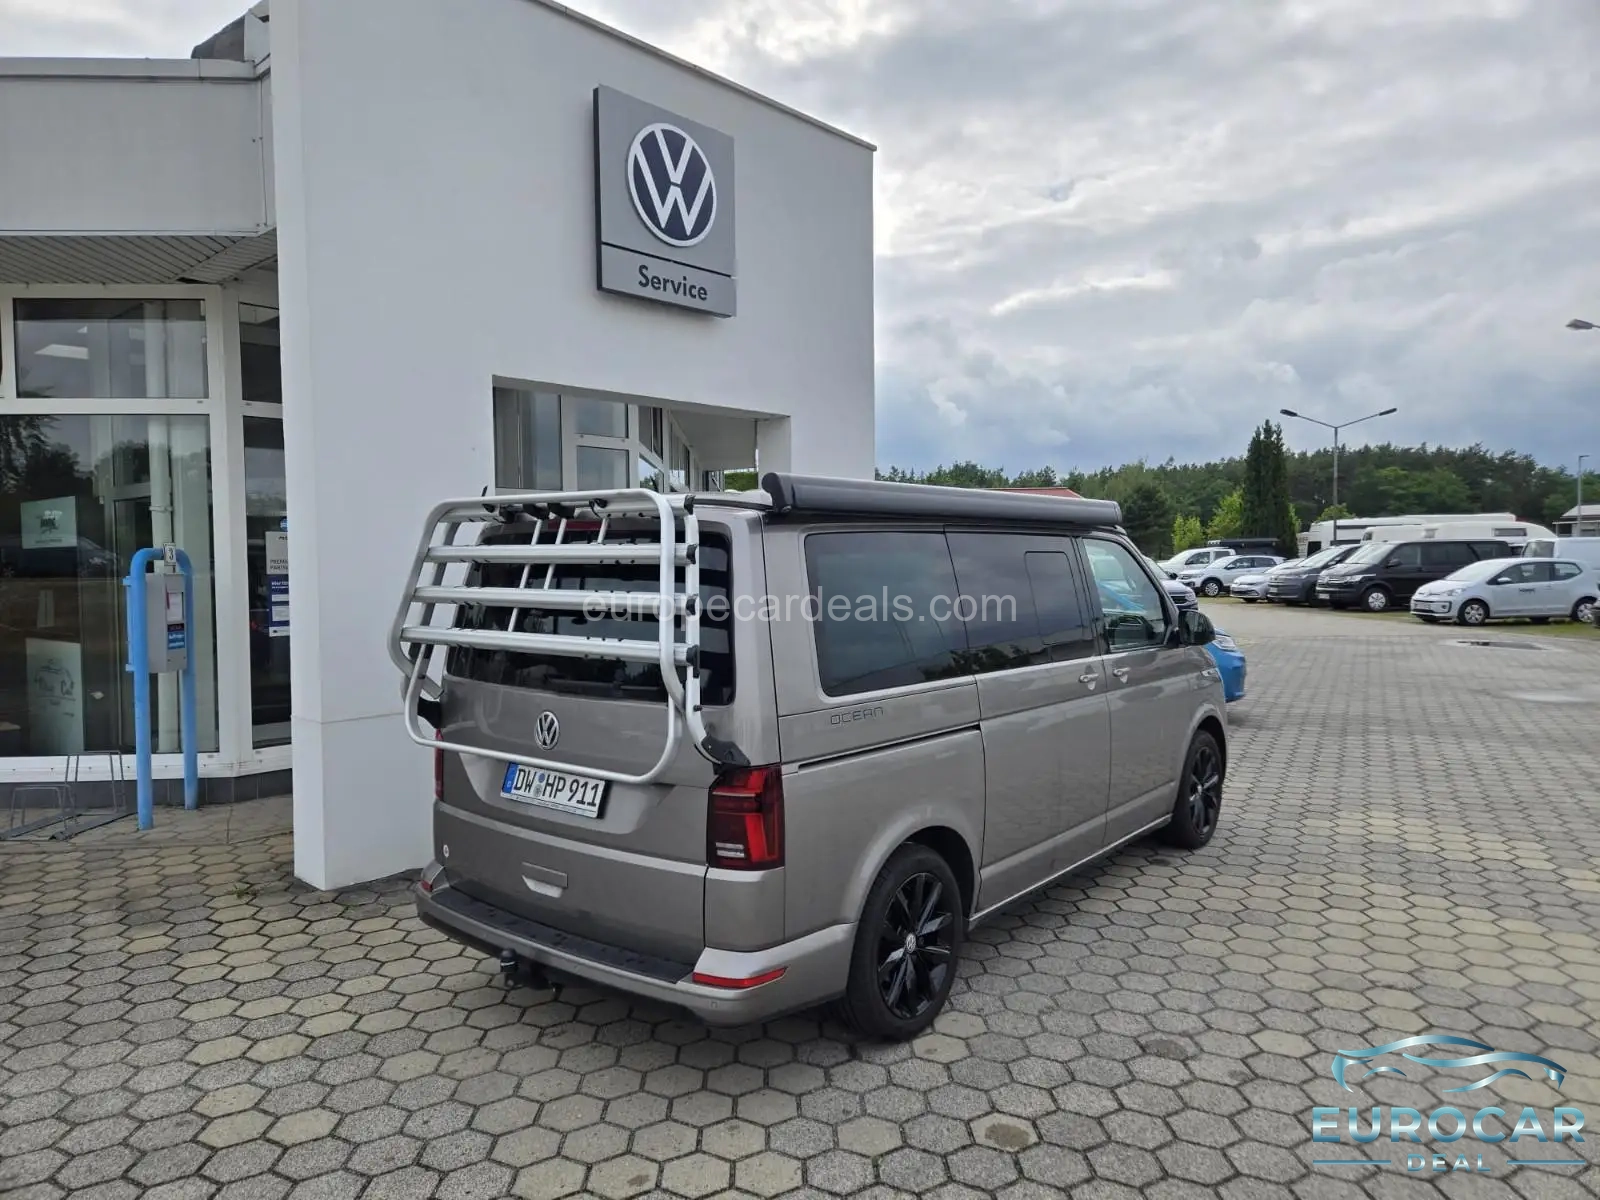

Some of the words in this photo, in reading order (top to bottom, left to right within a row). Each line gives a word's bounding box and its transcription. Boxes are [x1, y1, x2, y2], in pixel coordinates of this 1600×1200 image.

[628, 123, 717, 247] VW
[638, 264, 708, 301] Service
[831, 706, 884, 724] OCEAN
[513, 768, 537, 793] DW
[542, 774, 566, 799] HP
[568, 778, 600, 807] 911
